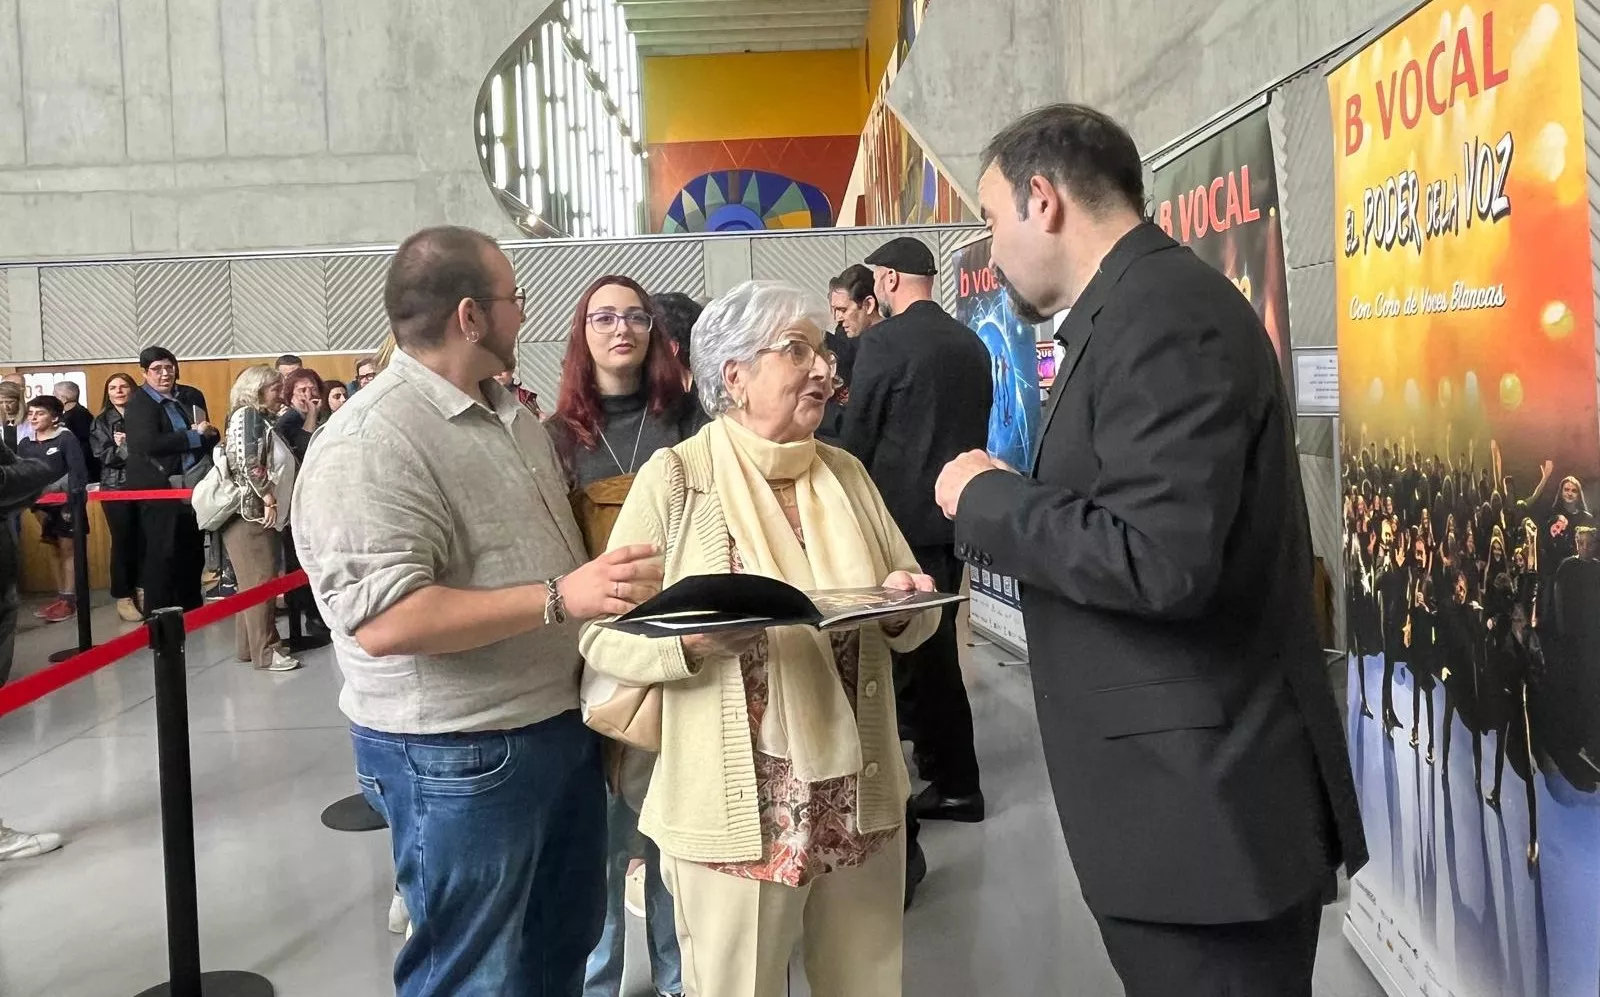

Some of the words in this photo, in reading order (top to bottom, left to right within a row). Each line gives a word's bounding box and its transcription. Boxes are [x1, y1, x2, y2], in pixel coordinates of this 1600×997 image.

[1346, 93, 1364, 157] B
[1376, 11, 1509, 140] VOCAL
[1160, 200, 1173, 239] B
[1178, 164, 1260, 243] VOCAL
[1345, 209, 1360, 258] EL
[1363, 170, 1421, 256] PODER
[1464, 131, 1514, 229] VOZ
[972, 266, 998, 294] voc
[1351, 296, 1372, 320] Con
[1376, 292, 1401, 318] Coro
[1404, 289, 1419, 316] de
[1421, 287, 1449, 314] Voces
[1451, 279, 1507, 312] Blancas
